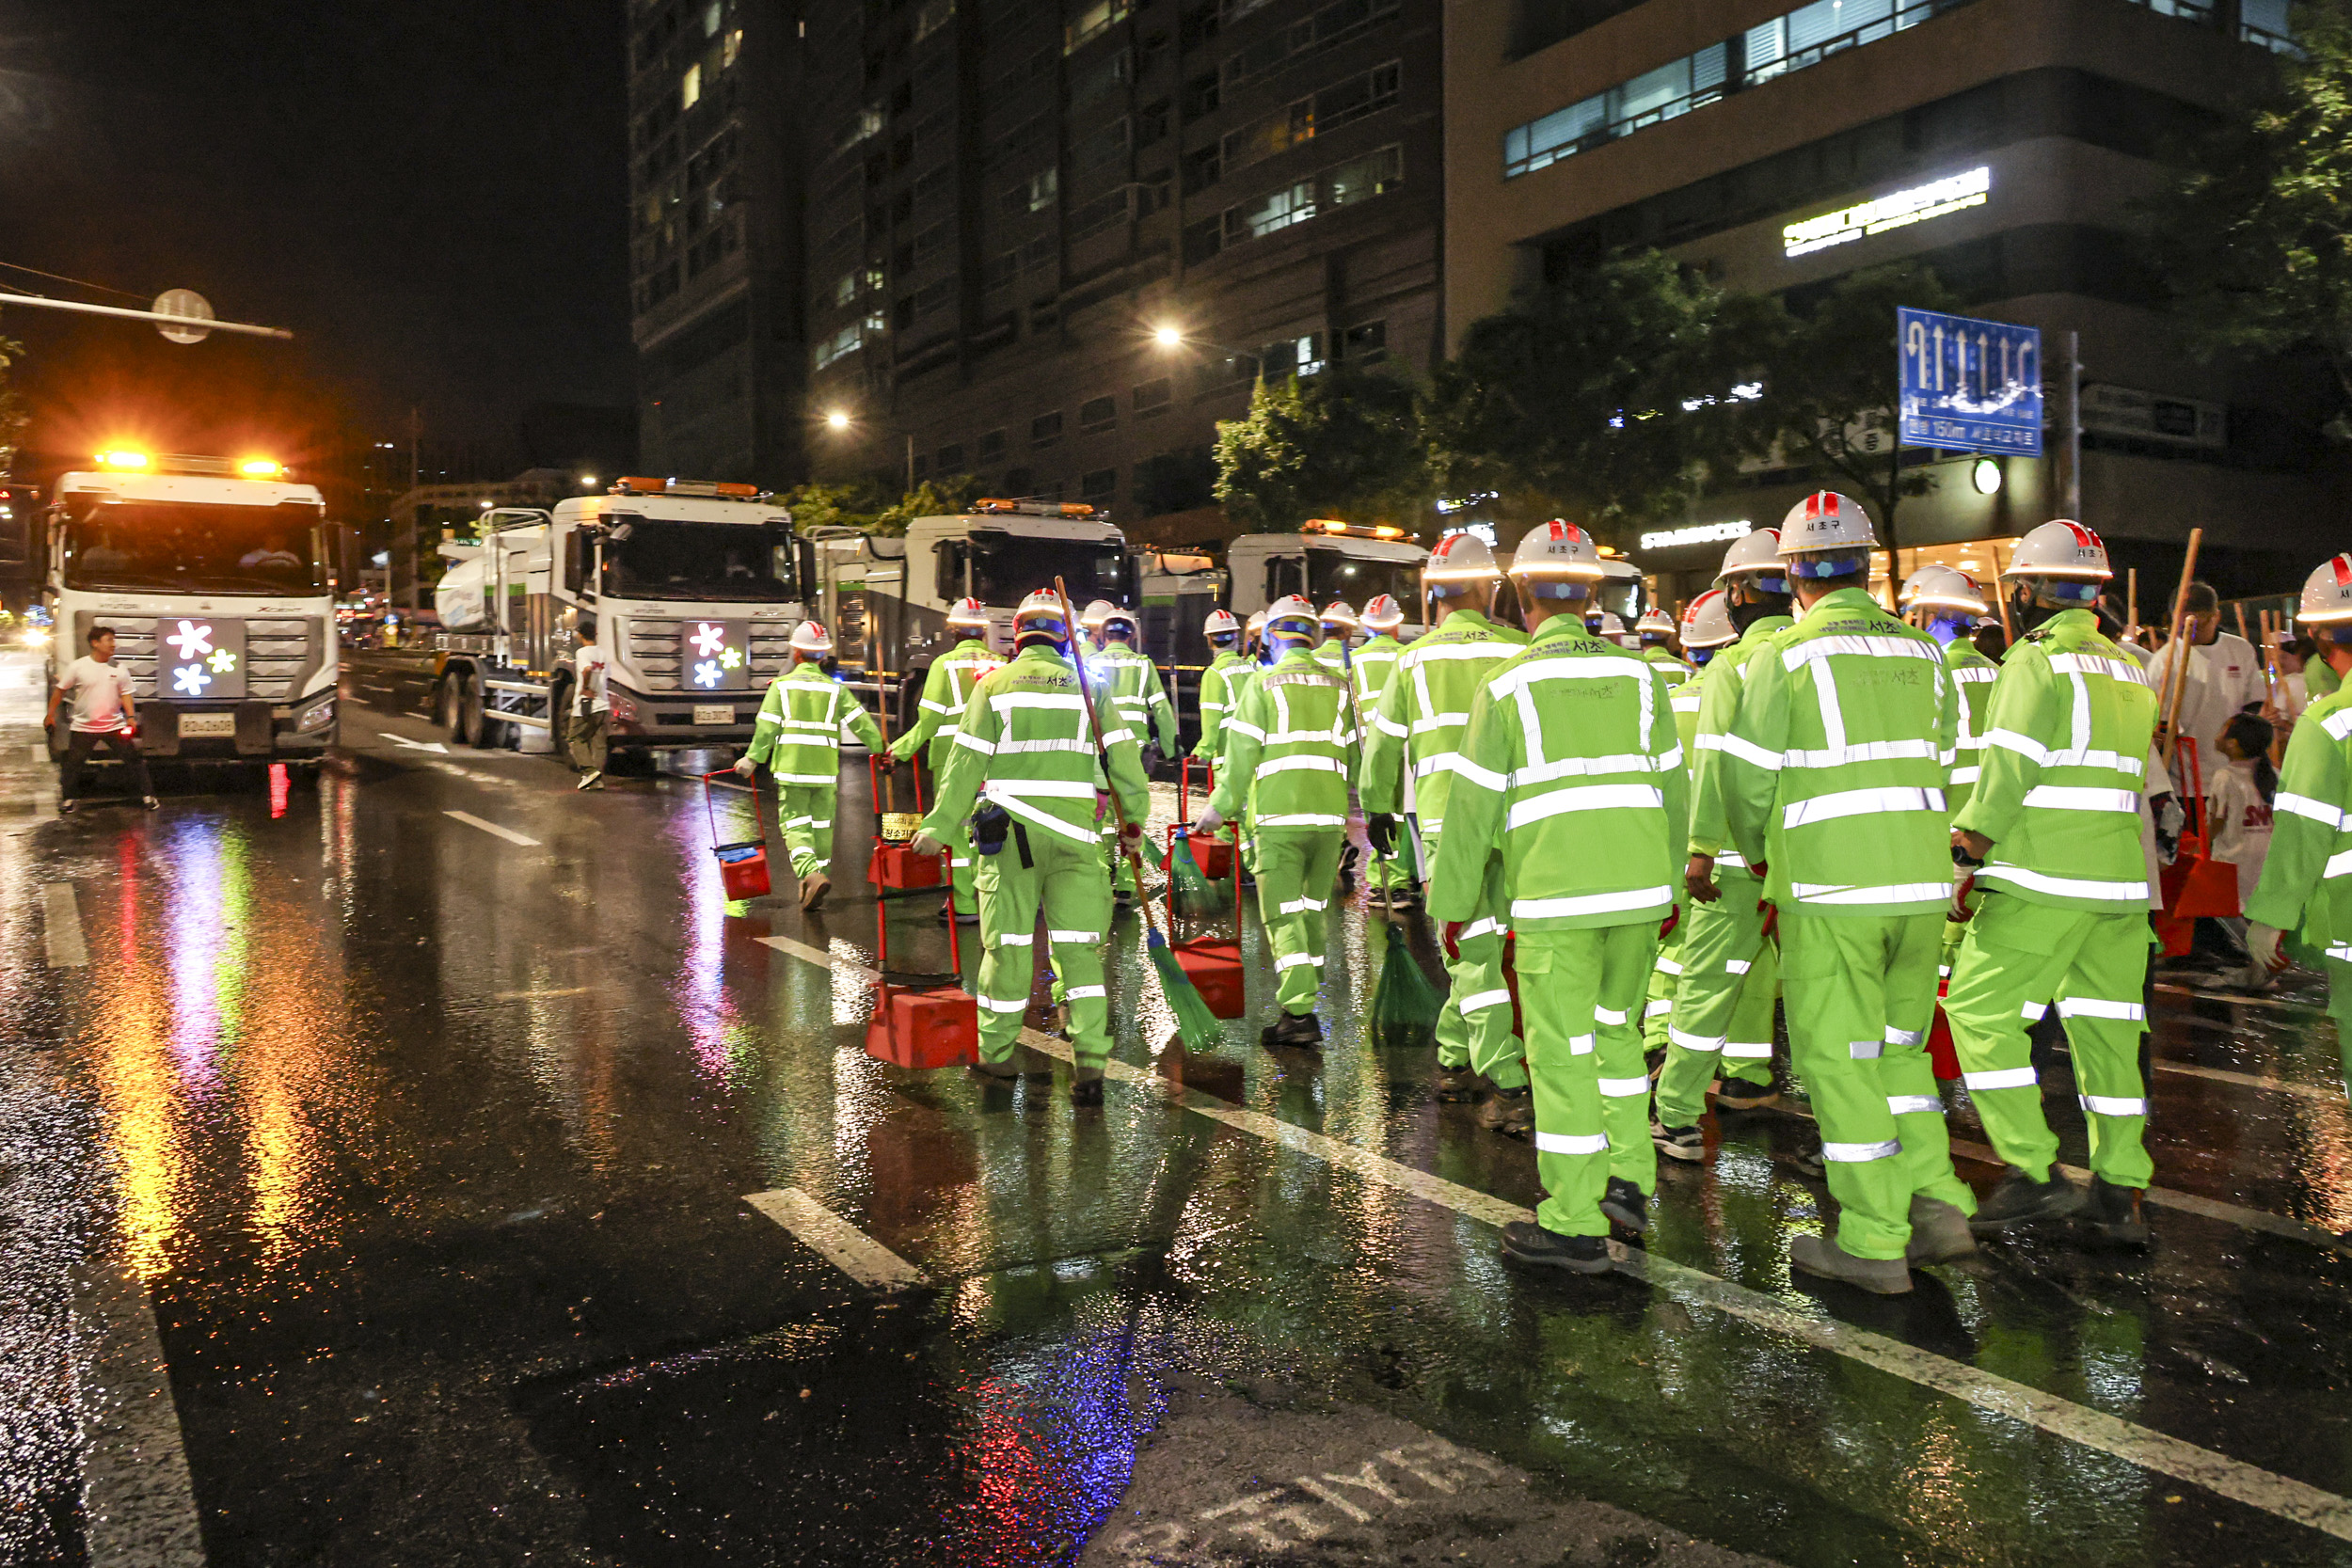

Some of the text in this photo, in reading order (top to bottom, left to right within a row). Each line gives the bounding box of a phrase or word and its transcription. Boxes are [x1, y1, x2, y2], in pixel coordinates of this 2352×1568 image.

[1805, 520, 1840, 531] 서초구
[1548, 546, 1579, 554] 서초구
[1869, 620, 1900, 634] 서초
[1464, 630, 1488, 641] 서초
[1573, 641, 1605, 653] 서초
[1047, 676, 1069, 688] 서초
